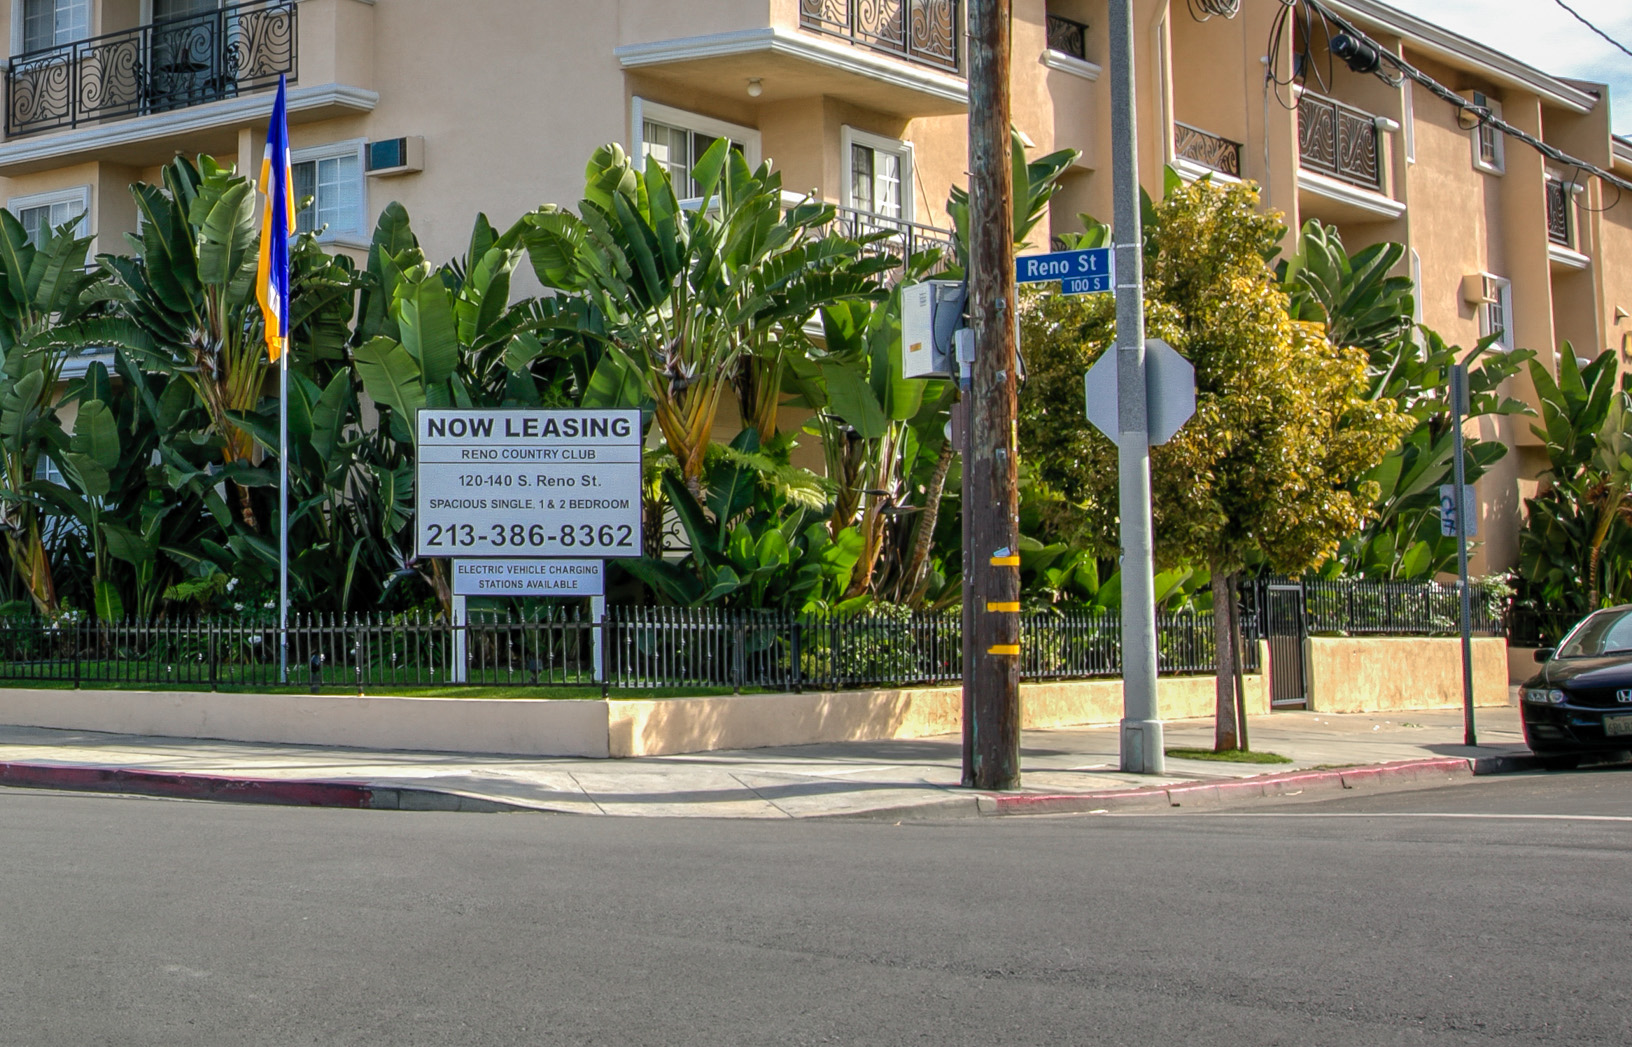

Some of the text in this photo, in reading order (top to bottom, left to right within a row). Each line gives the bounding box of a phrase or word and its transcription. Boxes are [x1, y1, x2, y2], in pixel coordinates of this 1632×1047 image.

[1027, 255, 1097, 277] Reno St
[1071, 278, 1101, 292] 100 S
[428, 417, 631, 438] NOW LEASING
[461, 449, 596, 460] RENO COUNTRY CLUB
[458, 474, 602, 487] 120-140 S. Reno St.
[429, 499, 487, 509] SPACIOUS
[539, 499, 544, 509] 1
[547, 499, 556, 510] &
[559, 499, 566, 509] 2
[569, 499, 630, 509] BEDROOM
[426, 523, 633, 547] 213-386-8362
[458, 565, 599, 575] ELECTRIC VEHICLE CHARGING
[478, 579, 578, 589] STATIONS AVAILABLE
